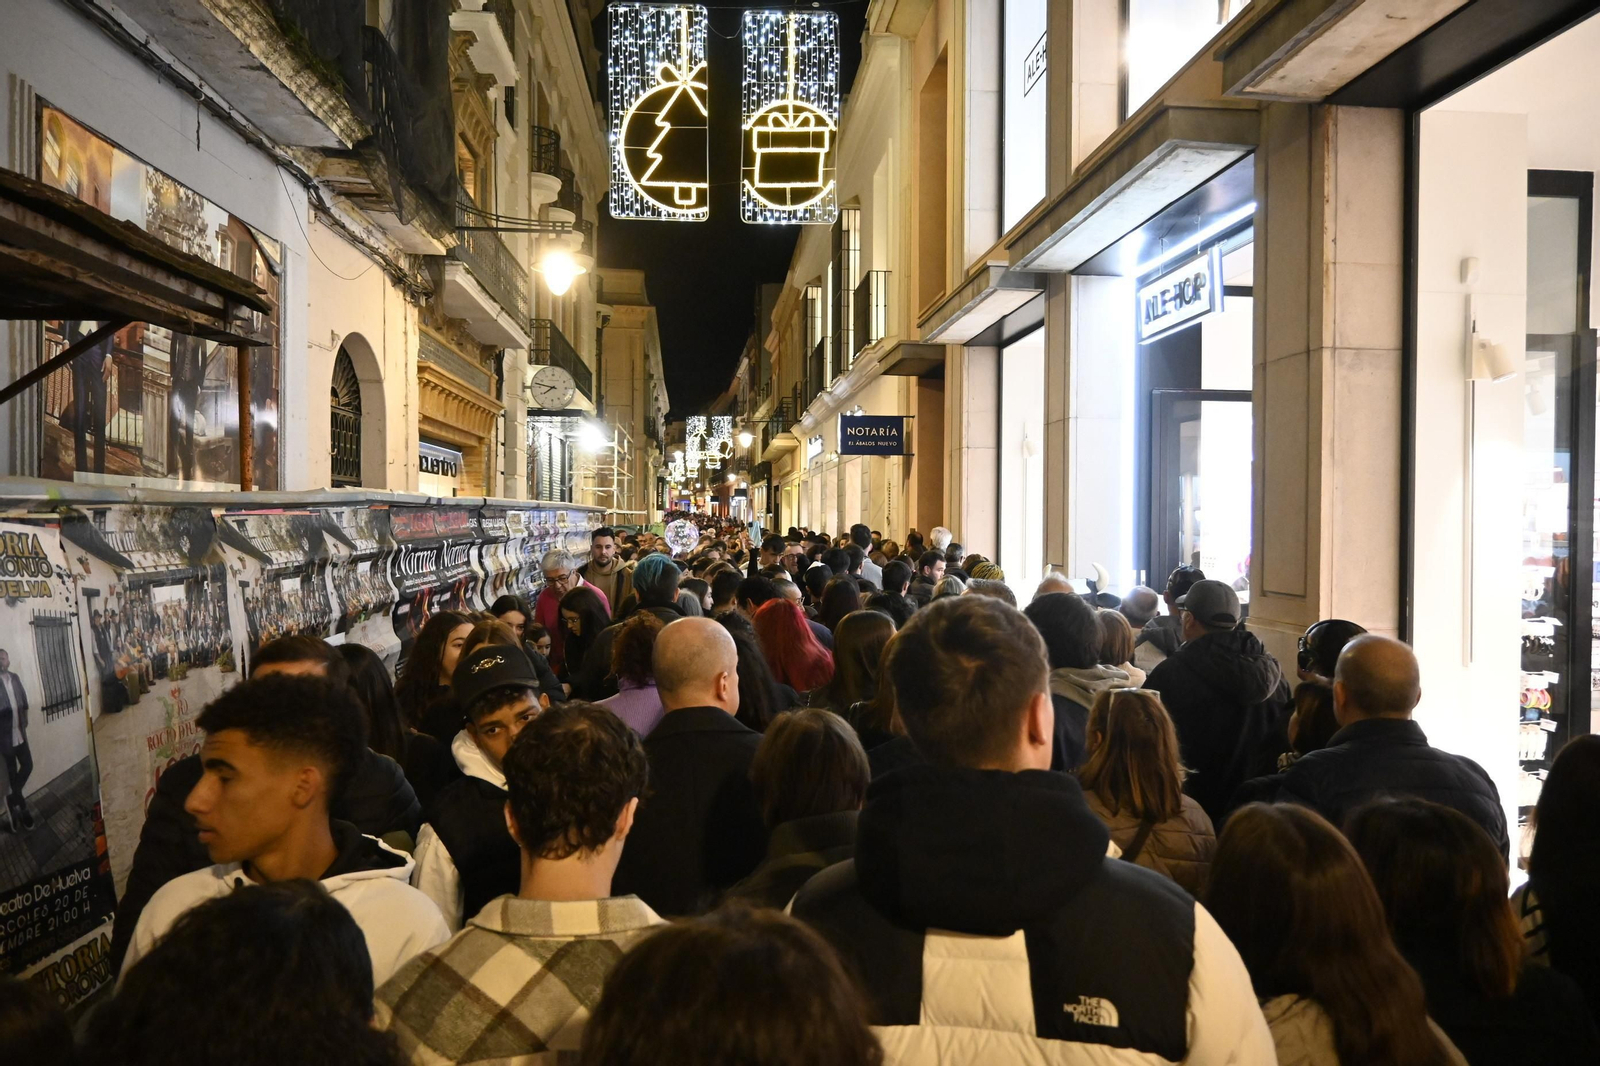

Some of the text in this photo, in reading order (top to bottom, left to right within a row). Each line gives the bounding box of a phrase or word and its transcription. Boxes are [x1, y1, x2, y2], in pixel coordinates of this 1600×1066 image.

[847, 425, 898, 436] NOTARÍA
[396, 538, 470, 577] Norma Norma
[0, 555, 53, 578] ONJO
[34, 884, 51, 902] De
[51, 867, 91, 894] Huelva
[55, 895, 69, 911] 20
[83, 901, 91, 914] H
[1078, 995, 1099, 1007] THE
[1063, 1003, 1098, 1016] NORTH
[1073, 1011, 1100, 1026] FACE
